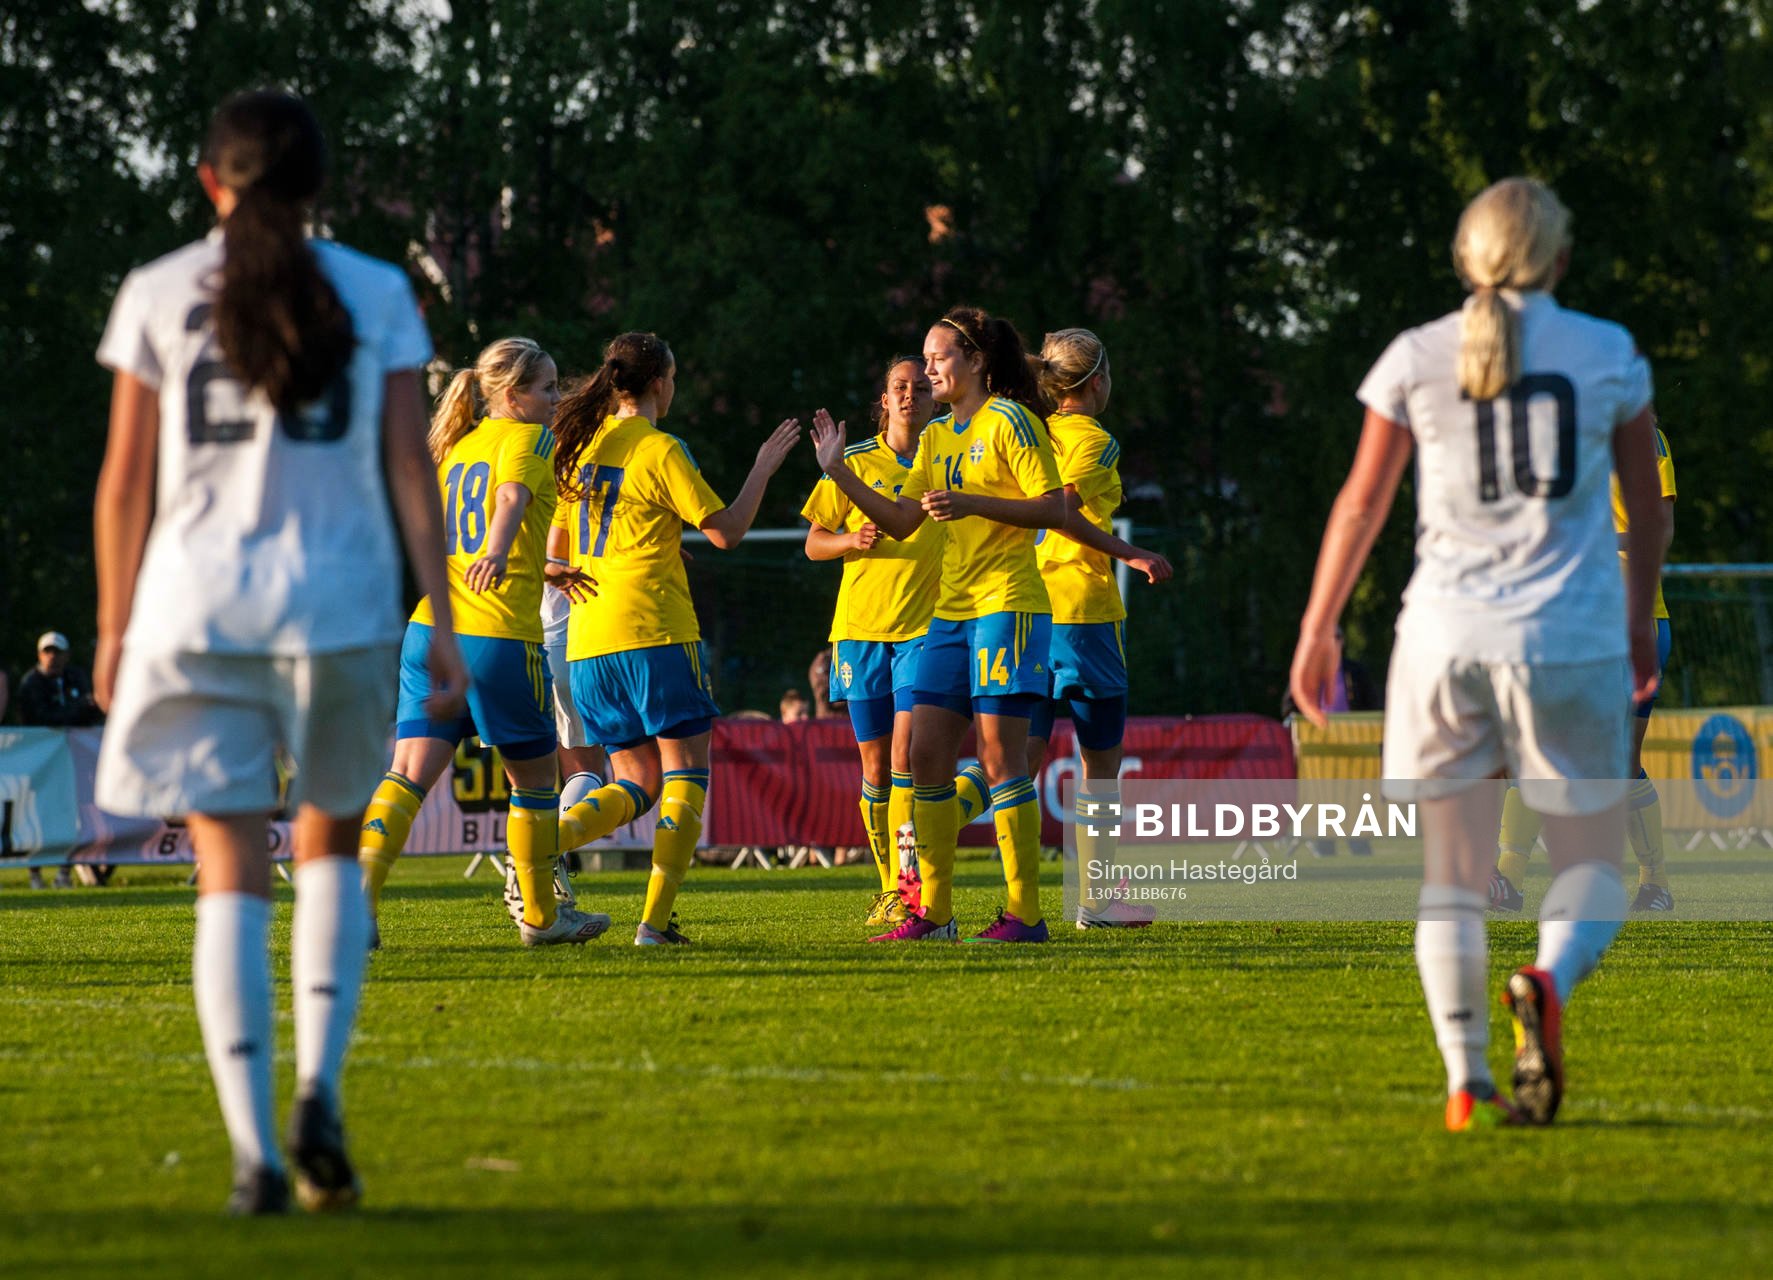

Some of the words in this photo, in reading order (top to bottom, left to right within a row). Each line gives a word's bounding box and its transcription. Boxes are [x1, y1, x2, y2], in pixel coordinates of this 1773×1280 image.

[945, 452, 964, 490] 14
[1459, 373, 1577, 502] 10
[444, 461, 490, 556] 18
[574, 462, 625, 558] 17
[977, 647, 1009, 686] 14
